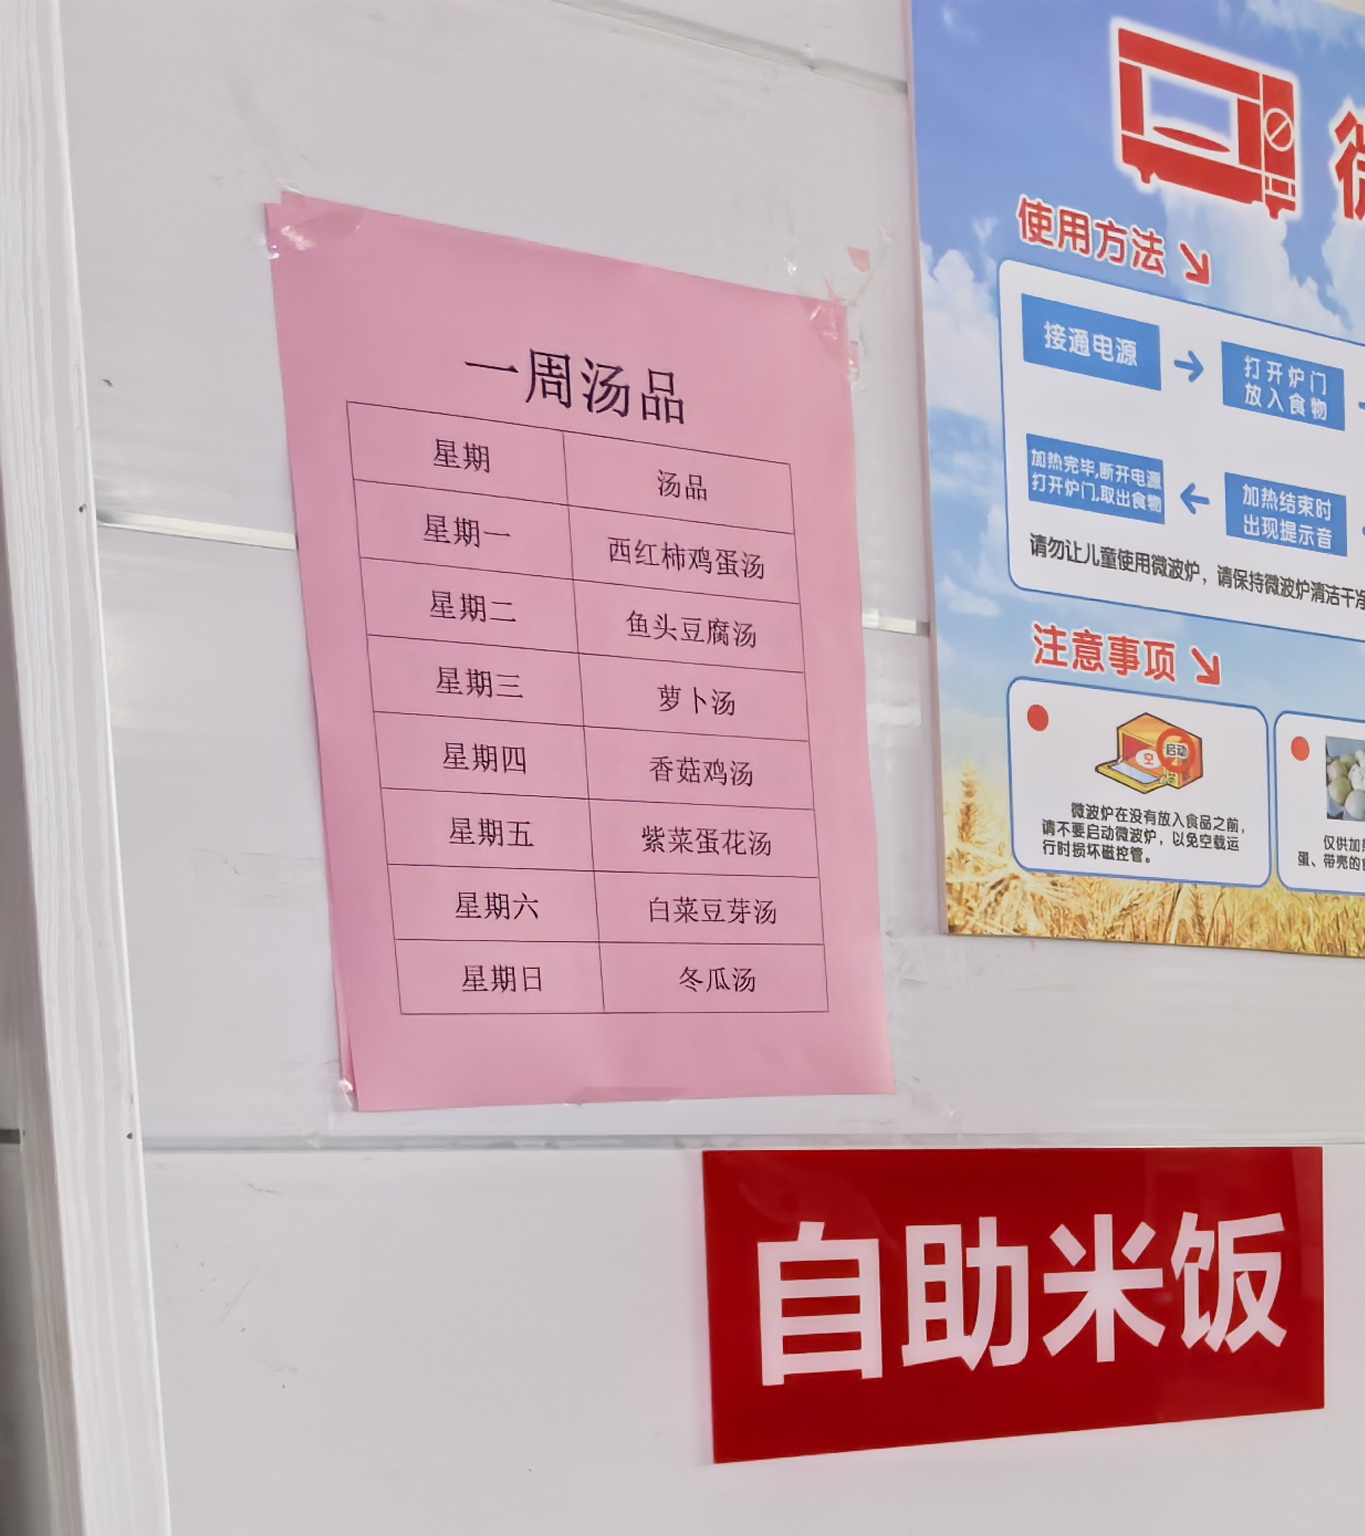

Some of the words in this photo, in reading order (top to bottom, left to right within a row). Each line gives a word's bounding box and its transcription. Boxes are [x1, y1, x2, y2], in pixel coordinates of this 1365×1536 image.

[1017, 196, 1166, 277] 使用方法
[1043, 321, 1139, 367] 接通电源
[464, 349, 685, 424] 一周汤品
[1244, 354, 1327, 397] 打开炉门
[1244, 382, 1328, 422] 放入食物
[432, 439, 490, 473] 星期
[657, 470, 708, 501] 汤品
[1242, 483, 1332, 522] 加热结束时
[423, 514, 511, 548] 星期一
[1243, 515, 1332, 550] 出现提示音
[608, 536, 765, 581] 西红柿鸡蛋汤
[430, 590, 516, 624] 星期二
[626, 610, 757, 648] 鱼头豆腐汤
[1032, 622, 1177, 681] 注意事项
[436, 666, 523, 699] 星期三
[657, 685, 736, 717] 萝卜汤
[443, 742, 527, 774] 星期四
[649, 756, 754, 788] 香菇鸡汤
[449, 816, 534, 849] 星期五
[641, 826, 772, 857] 紫菜蛋花汤
[455, 891, 539, 921] 星期六
[648, 897, 778, 926] 白菜豆芽汤
[462, 964, 543, 994] 星期日
[679, 967, 756, 993] 冬瓜汤
[758, 1211, 1288, 1386] 自助米饭
